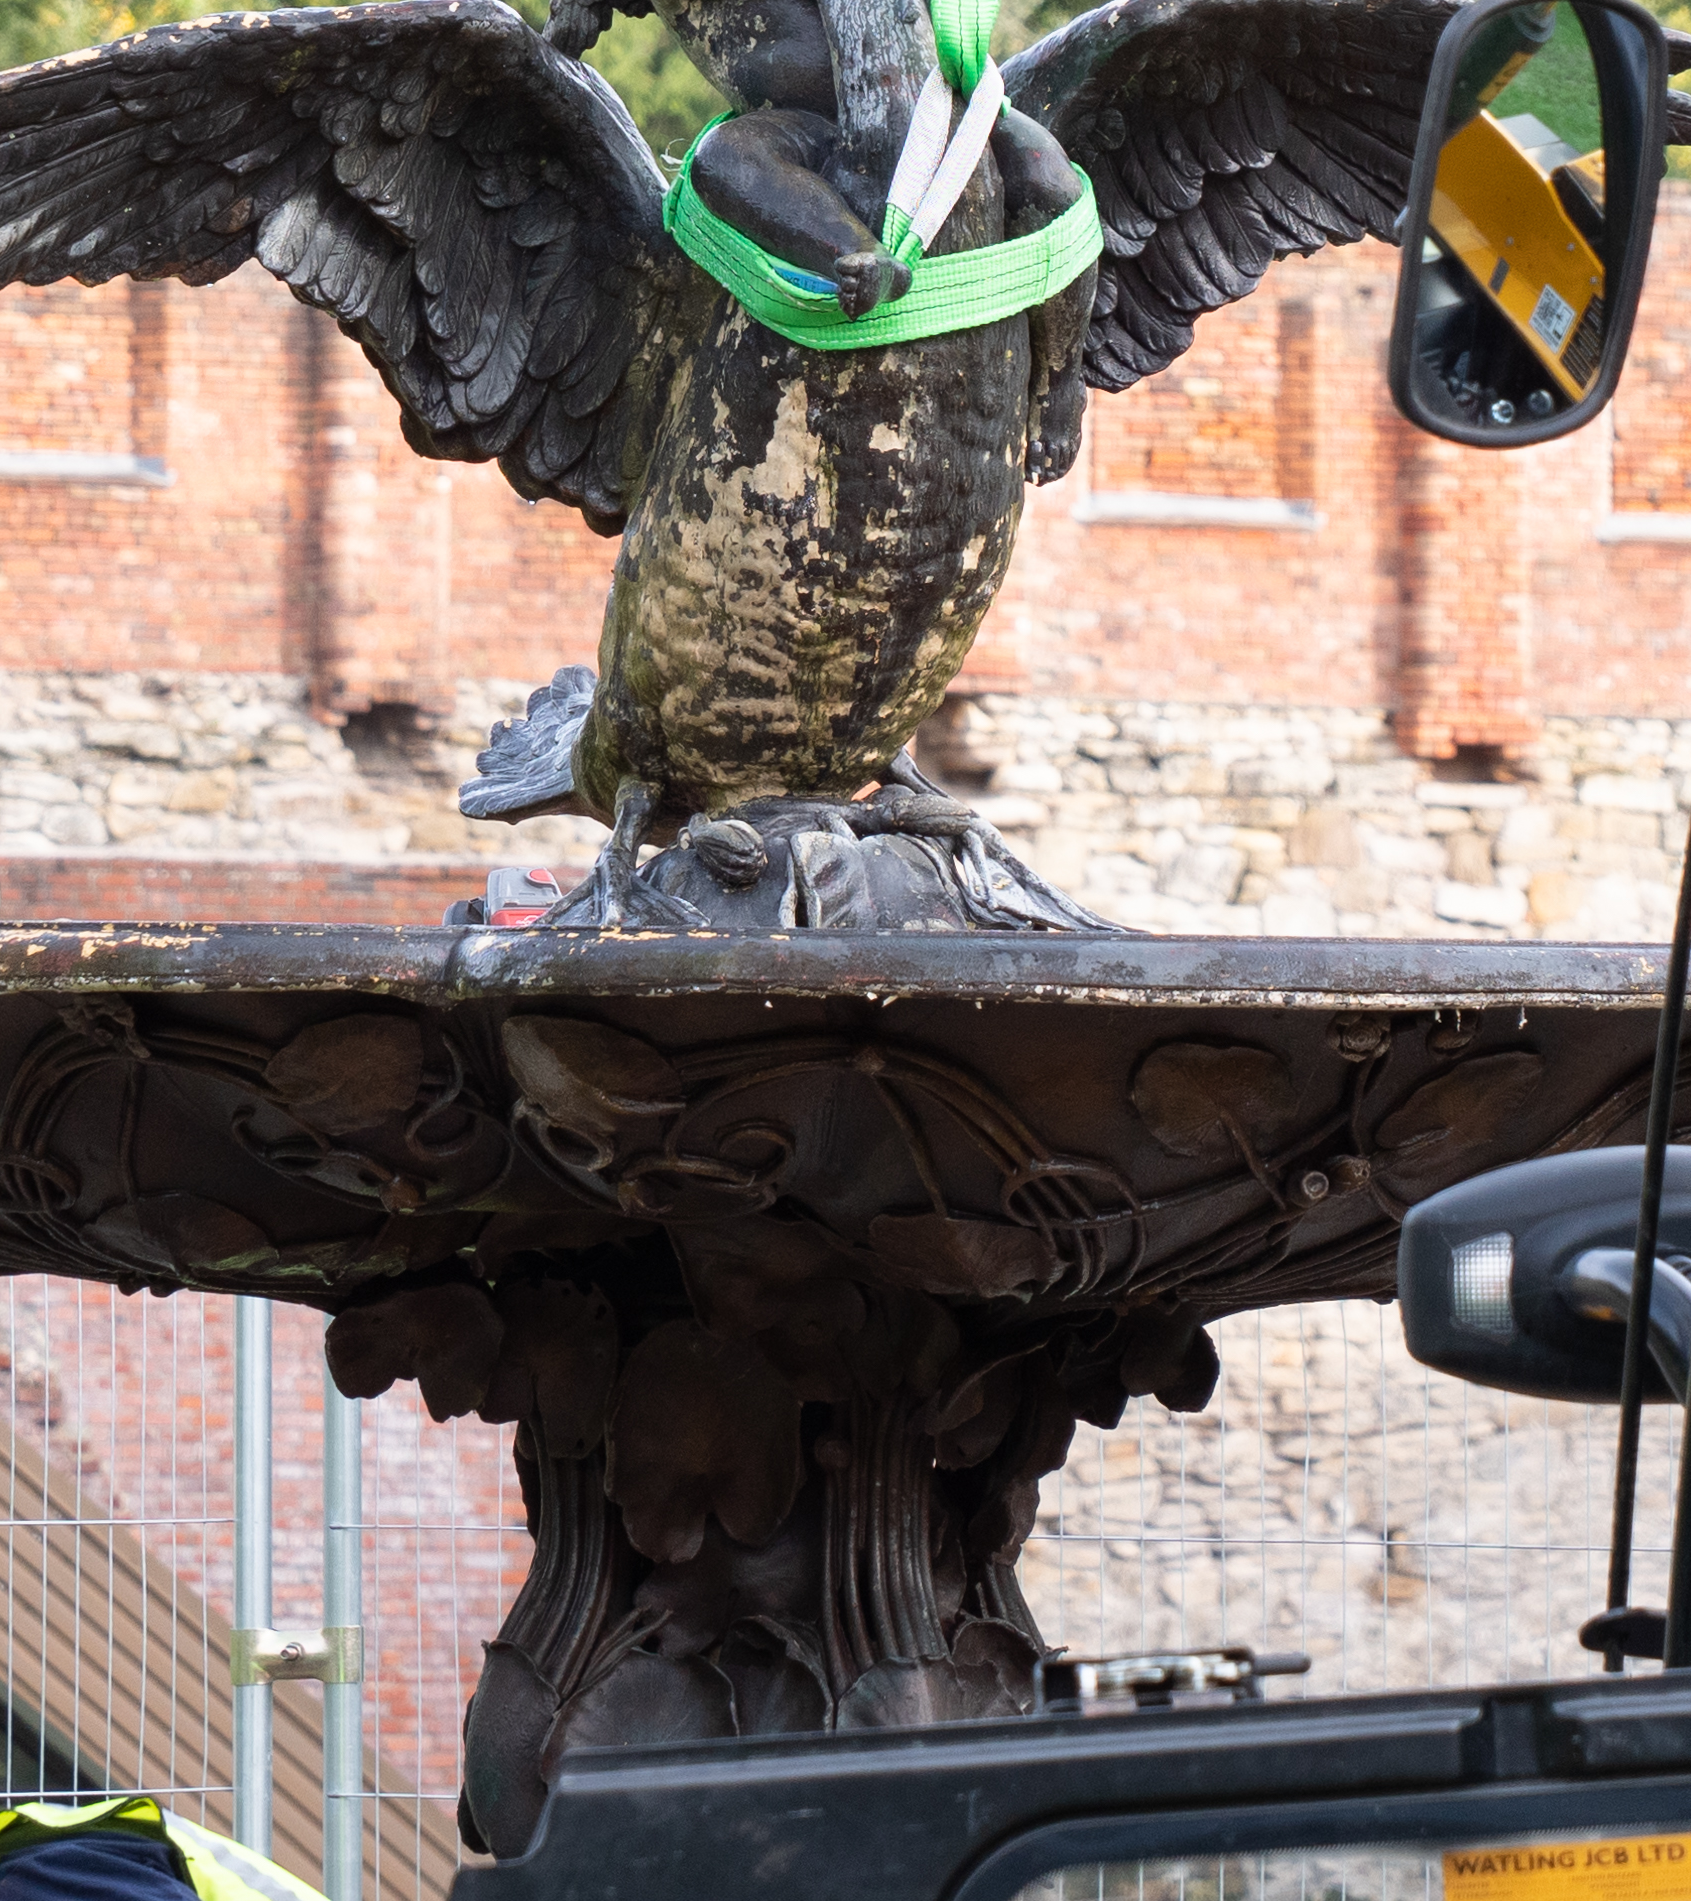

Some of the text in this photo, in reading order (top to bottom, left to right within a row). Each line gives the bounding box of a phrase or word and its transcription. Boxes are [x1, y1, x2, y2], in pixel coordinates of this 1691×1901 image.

[1453, 1842, 1686, 1875] WATLING JCB LTD
